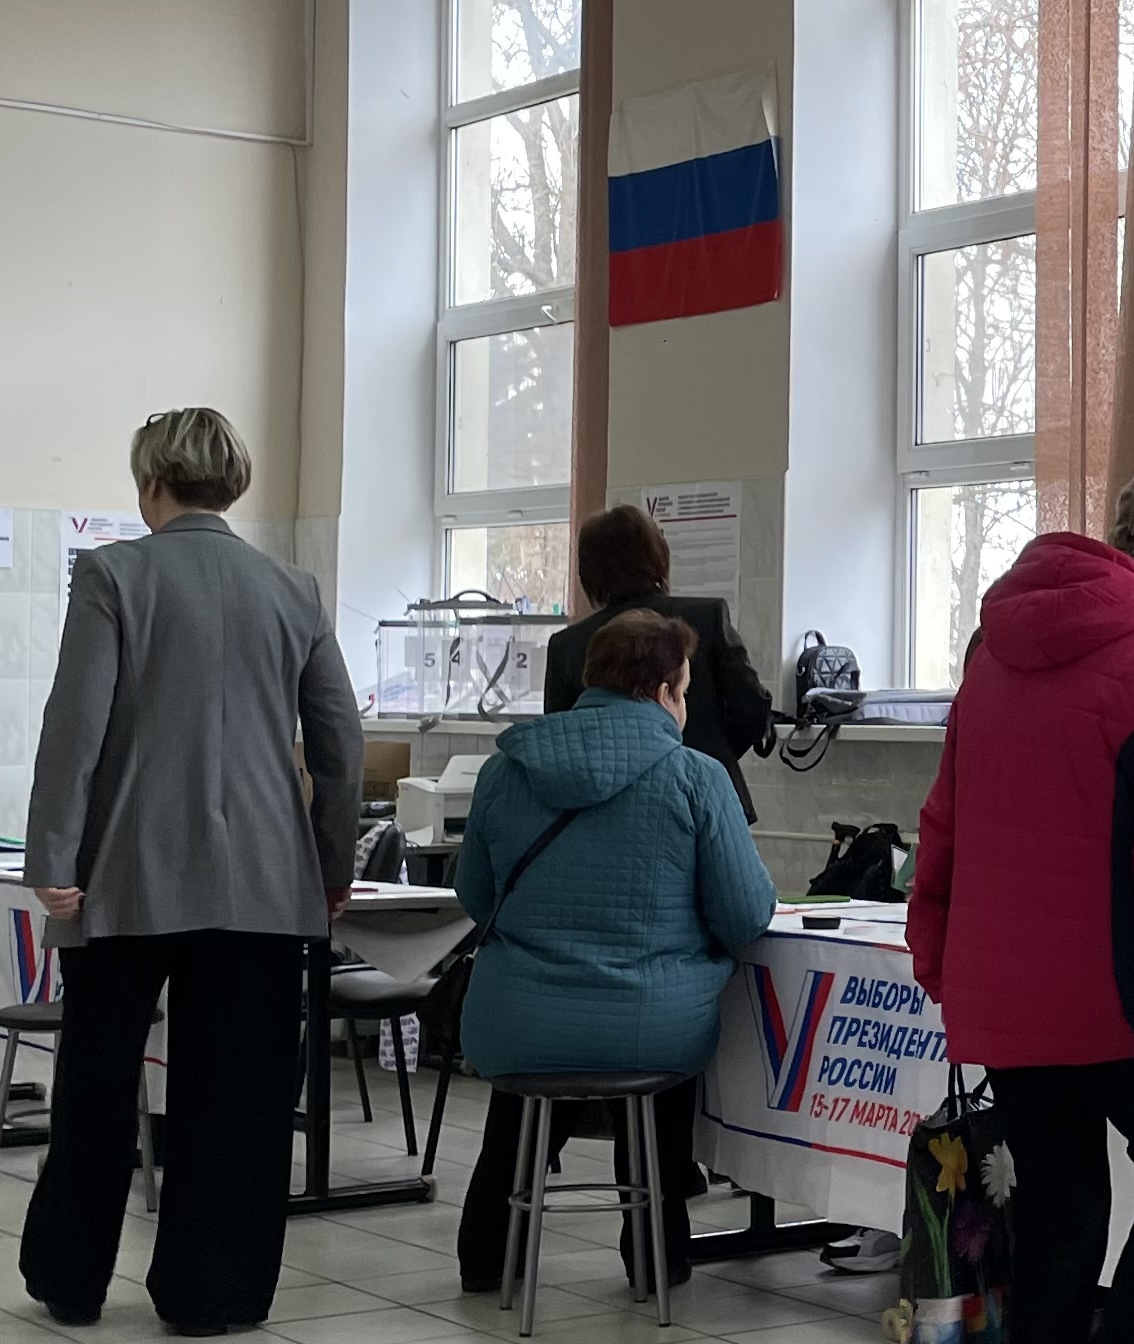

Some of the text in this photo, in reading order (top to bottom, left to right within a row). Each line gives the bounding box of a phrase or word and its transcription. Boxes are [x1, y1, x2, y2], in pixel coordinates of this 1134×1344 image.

[424, 653, 436, 668] 5
[451, 651, 461, 666] 4
[516, 652, 528, 669] 2
[840, 975, 927, 1016] ВЫБОРЫ
[817, 1055, 898, 1096] РОССИИ
[809, 1092, 921, 1137] 15-17 МАРТА 20
